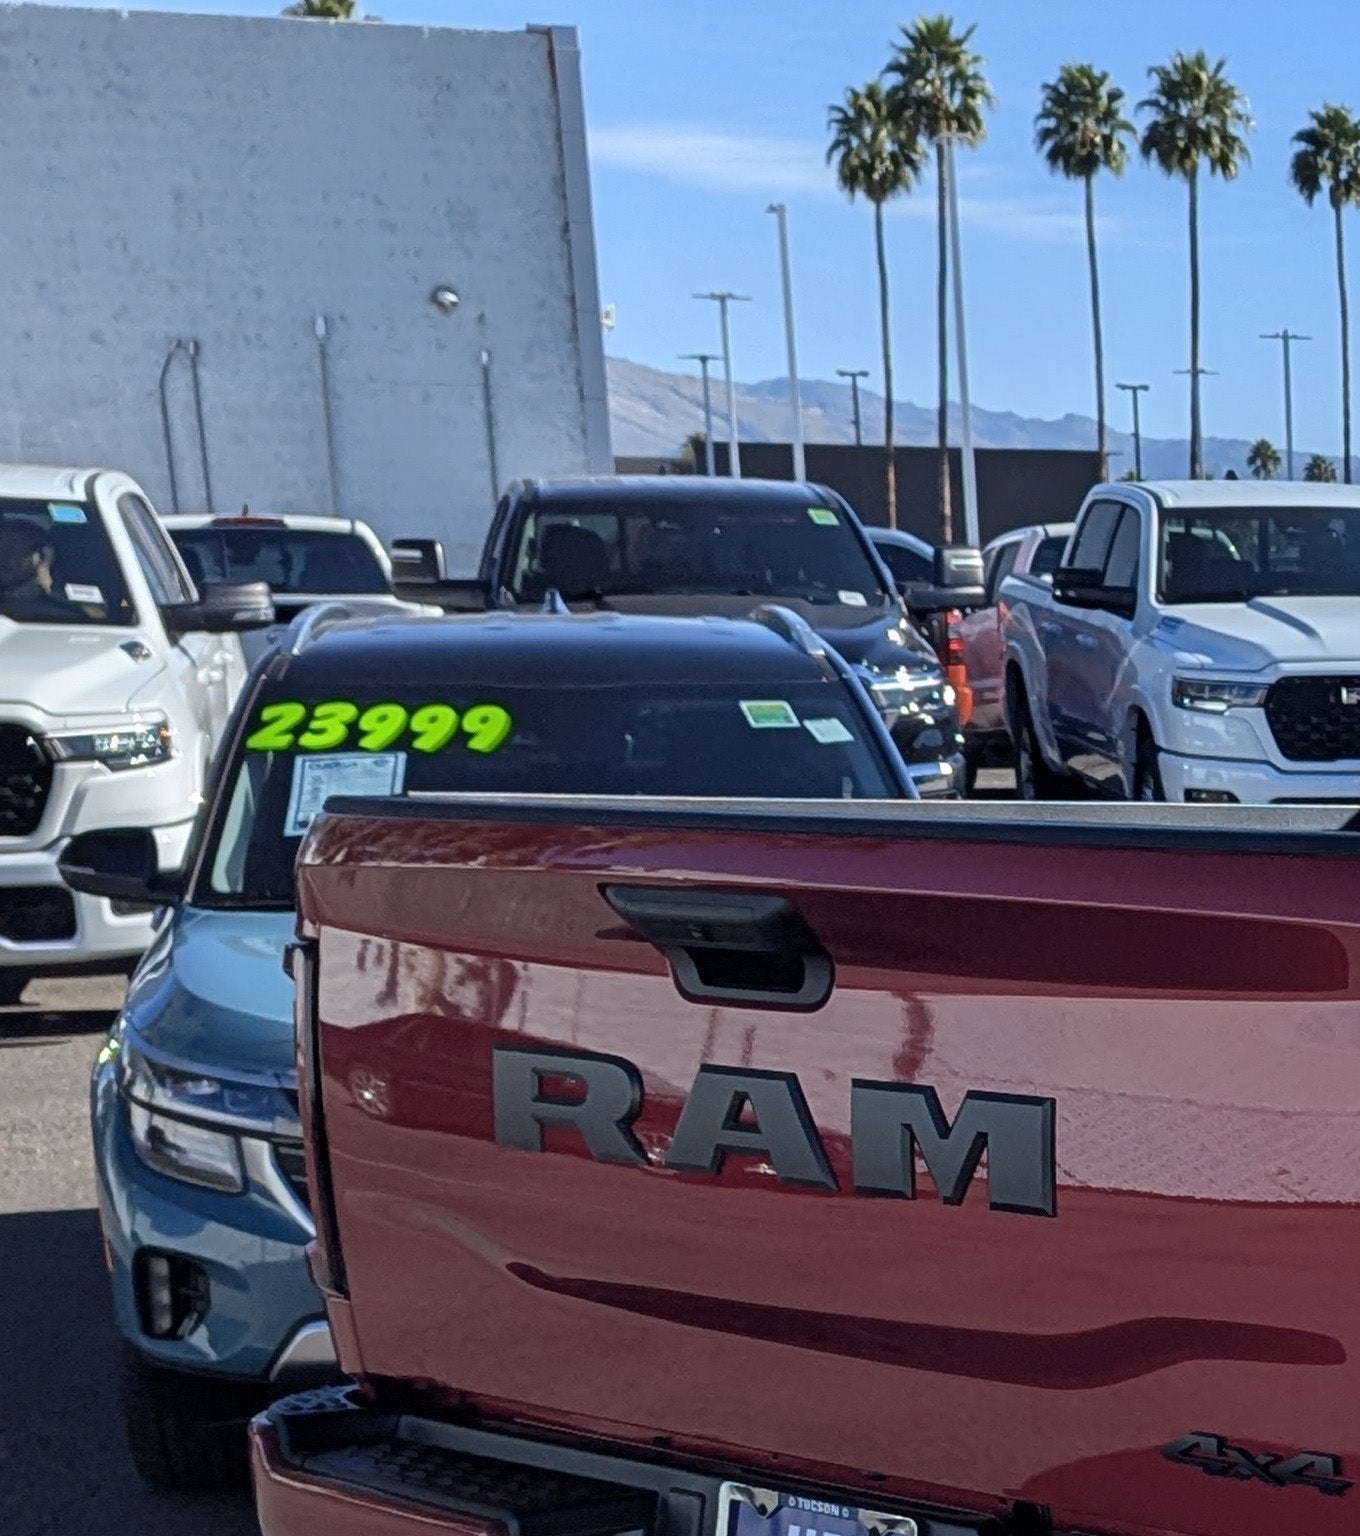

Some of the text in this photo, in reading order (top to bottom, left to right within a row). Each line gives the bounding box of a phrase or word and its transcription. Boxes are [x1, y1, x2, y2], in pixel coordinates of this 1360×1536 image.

[246, 701, 511, 752] 23999
[493, 1044, 1056, 1217] RAM
[798, 1496, 841, 1517] TUCSON
